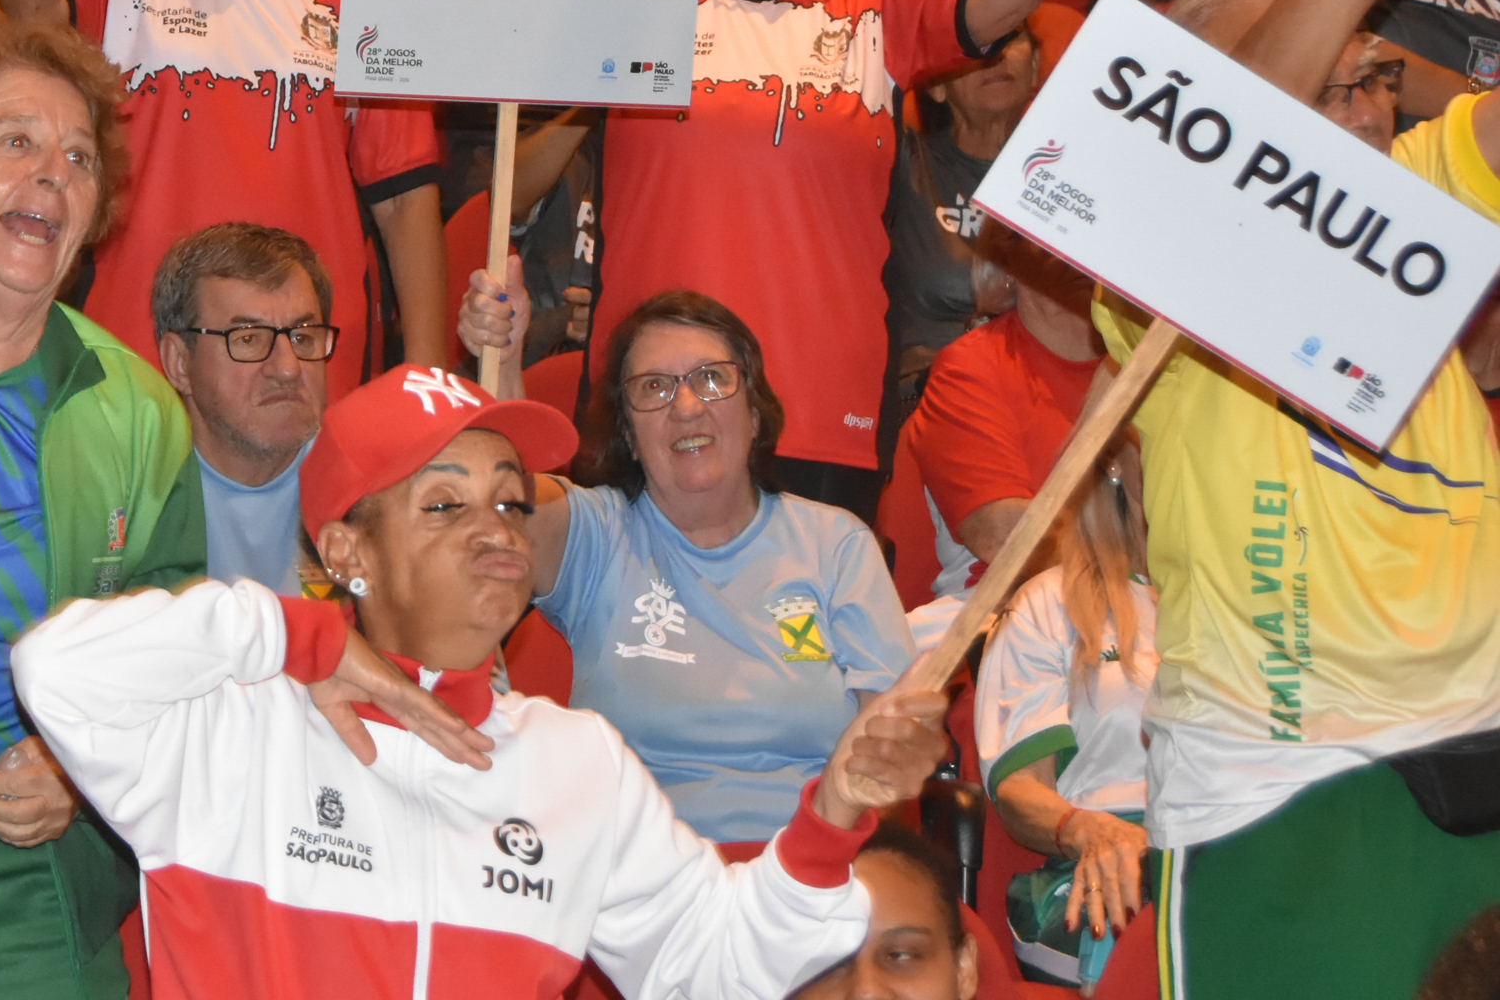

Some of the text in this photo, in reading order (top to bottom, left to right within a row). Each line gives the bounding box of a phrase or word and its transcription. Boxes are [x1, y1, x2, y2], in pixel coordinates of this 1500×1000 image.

[141, 3, 207, 19] Secretaria de
[162, 16, 208, 28] Esportes
[178, 25, 208, 37] Lazer
[701, 32, 715, 40] de
[366, 47, 416, 57] 28º JOGOS
[366, 57, 423, 67] DA MELHOR
[365, 66, 394, 75] IDADE
[1092, 55, 1446, 297] SÃO PAULO
[1034, 166, 1095, 208] 28º JOGOS
[1020, 188, 1058, 216] IDADE
[1028, 178, 1097, 225] DA MELHOR
[1244, 479, 1288, 595] VÔLEI
[357, 843, 373, 856] DE
[482, 865, 554, 904] JOMI
